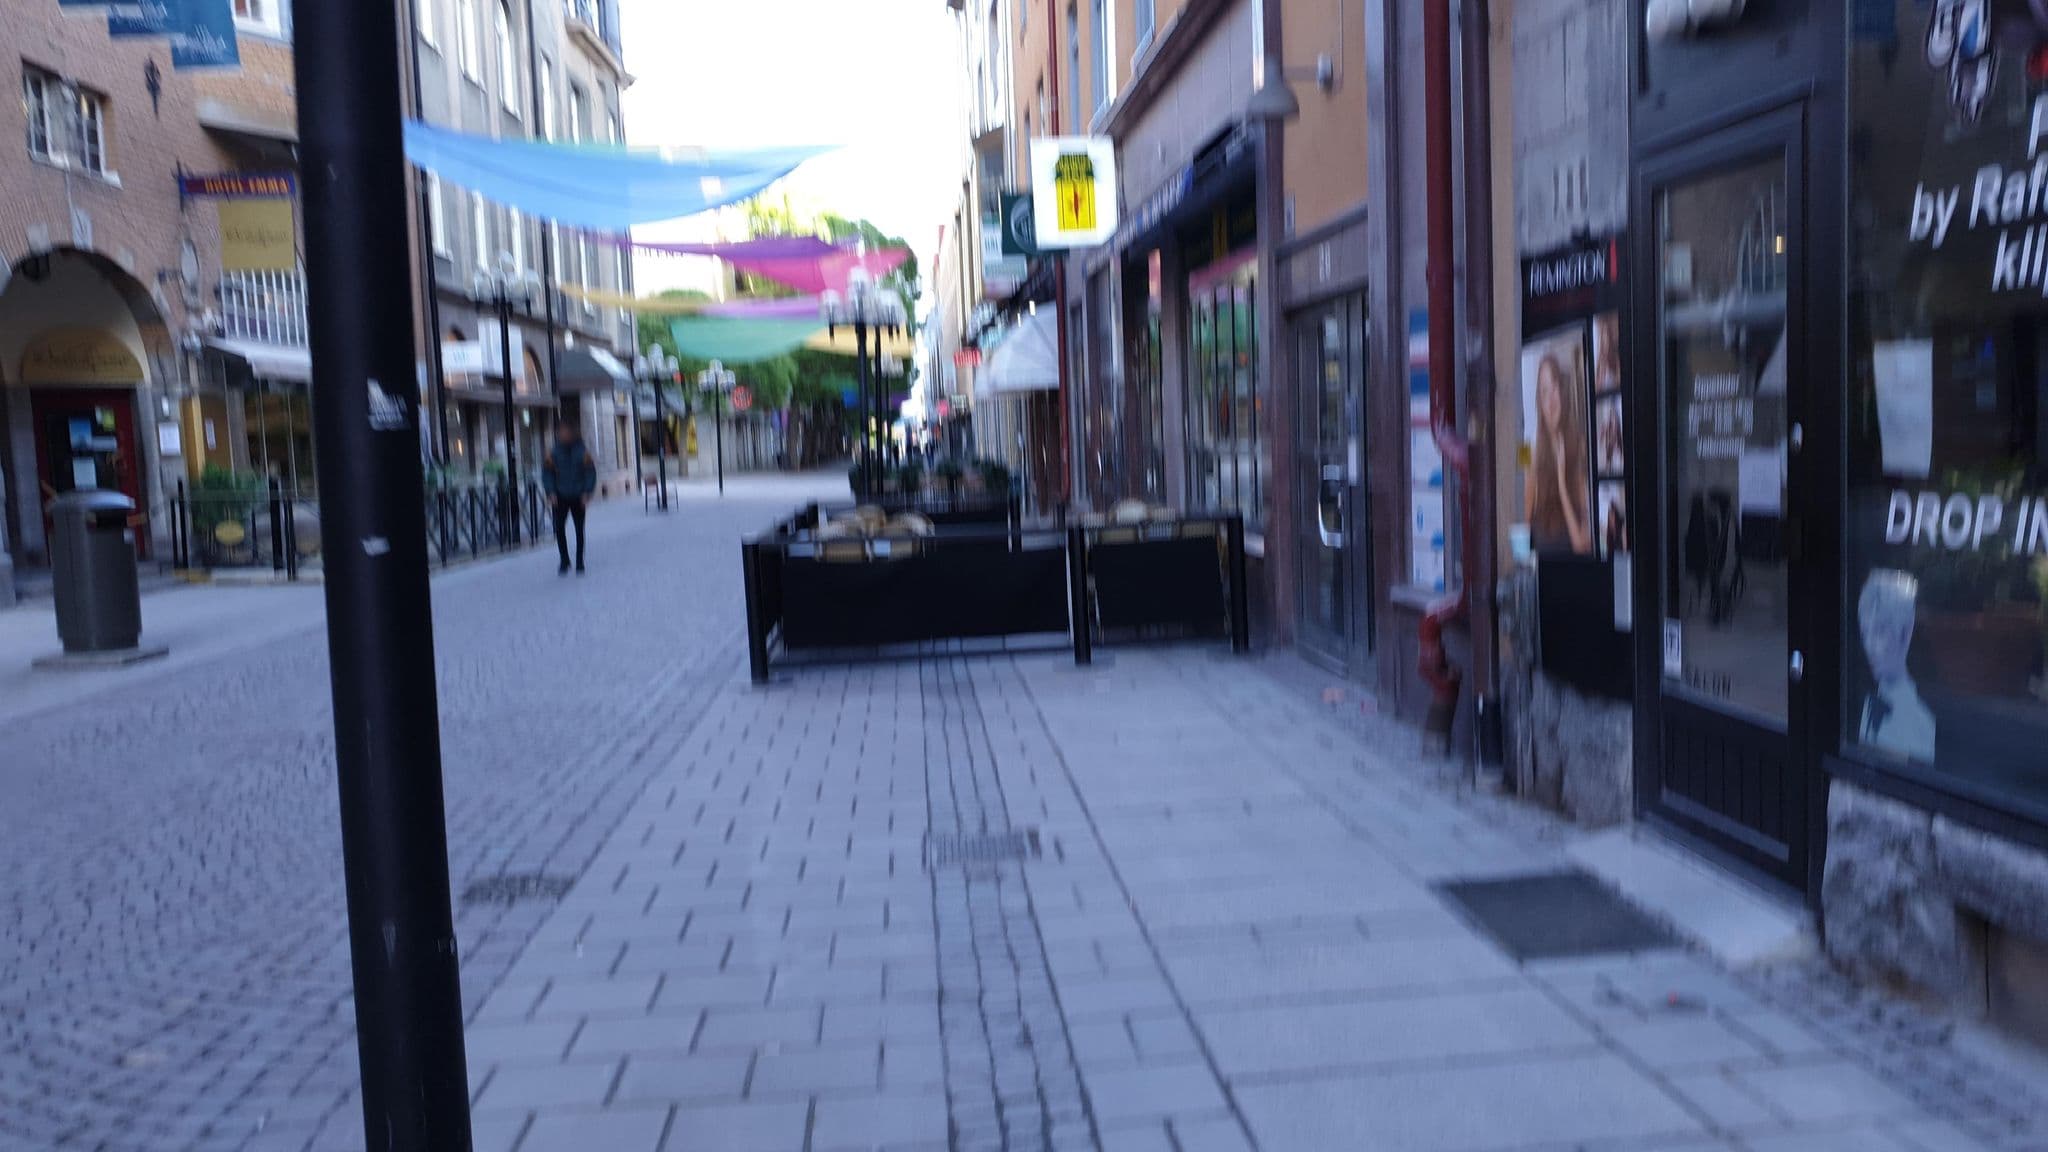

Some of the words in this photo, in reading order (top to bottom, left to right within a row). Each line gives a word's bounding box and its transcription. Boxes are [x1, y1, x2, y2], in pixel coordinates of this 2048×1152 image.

[1909, 180, 1960, 249] by
[1529, 247, 1607, 300] REMINGTON
[1885, 488, 2004, 554] DROP
